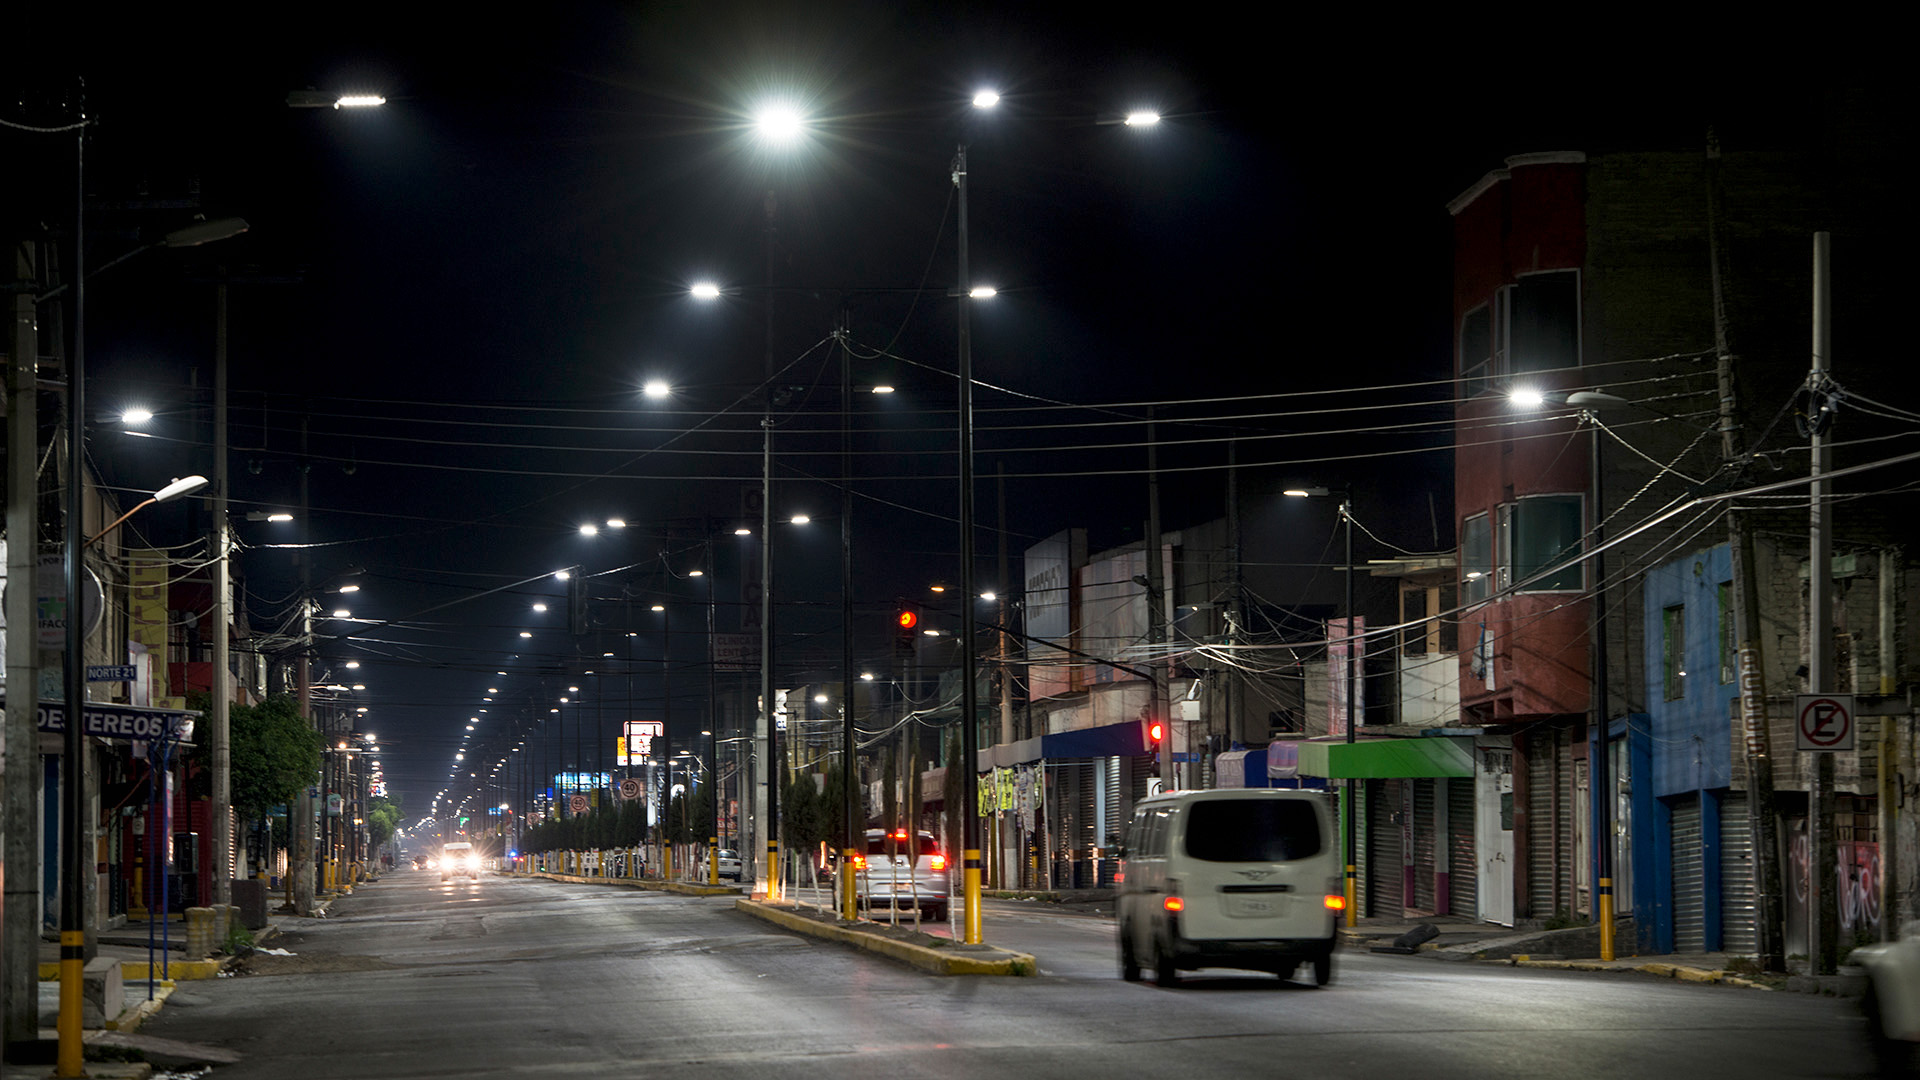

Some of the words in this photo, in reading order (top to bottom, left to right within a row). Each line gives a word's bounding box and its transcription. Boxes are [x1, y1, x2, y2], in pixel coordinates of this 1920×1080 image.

[88, 667, 122, 679] NORTE
[123, 667, 135, 678] 21
[1814, 705, 1836, 737] E
[624, 783, 635, 791] 40
